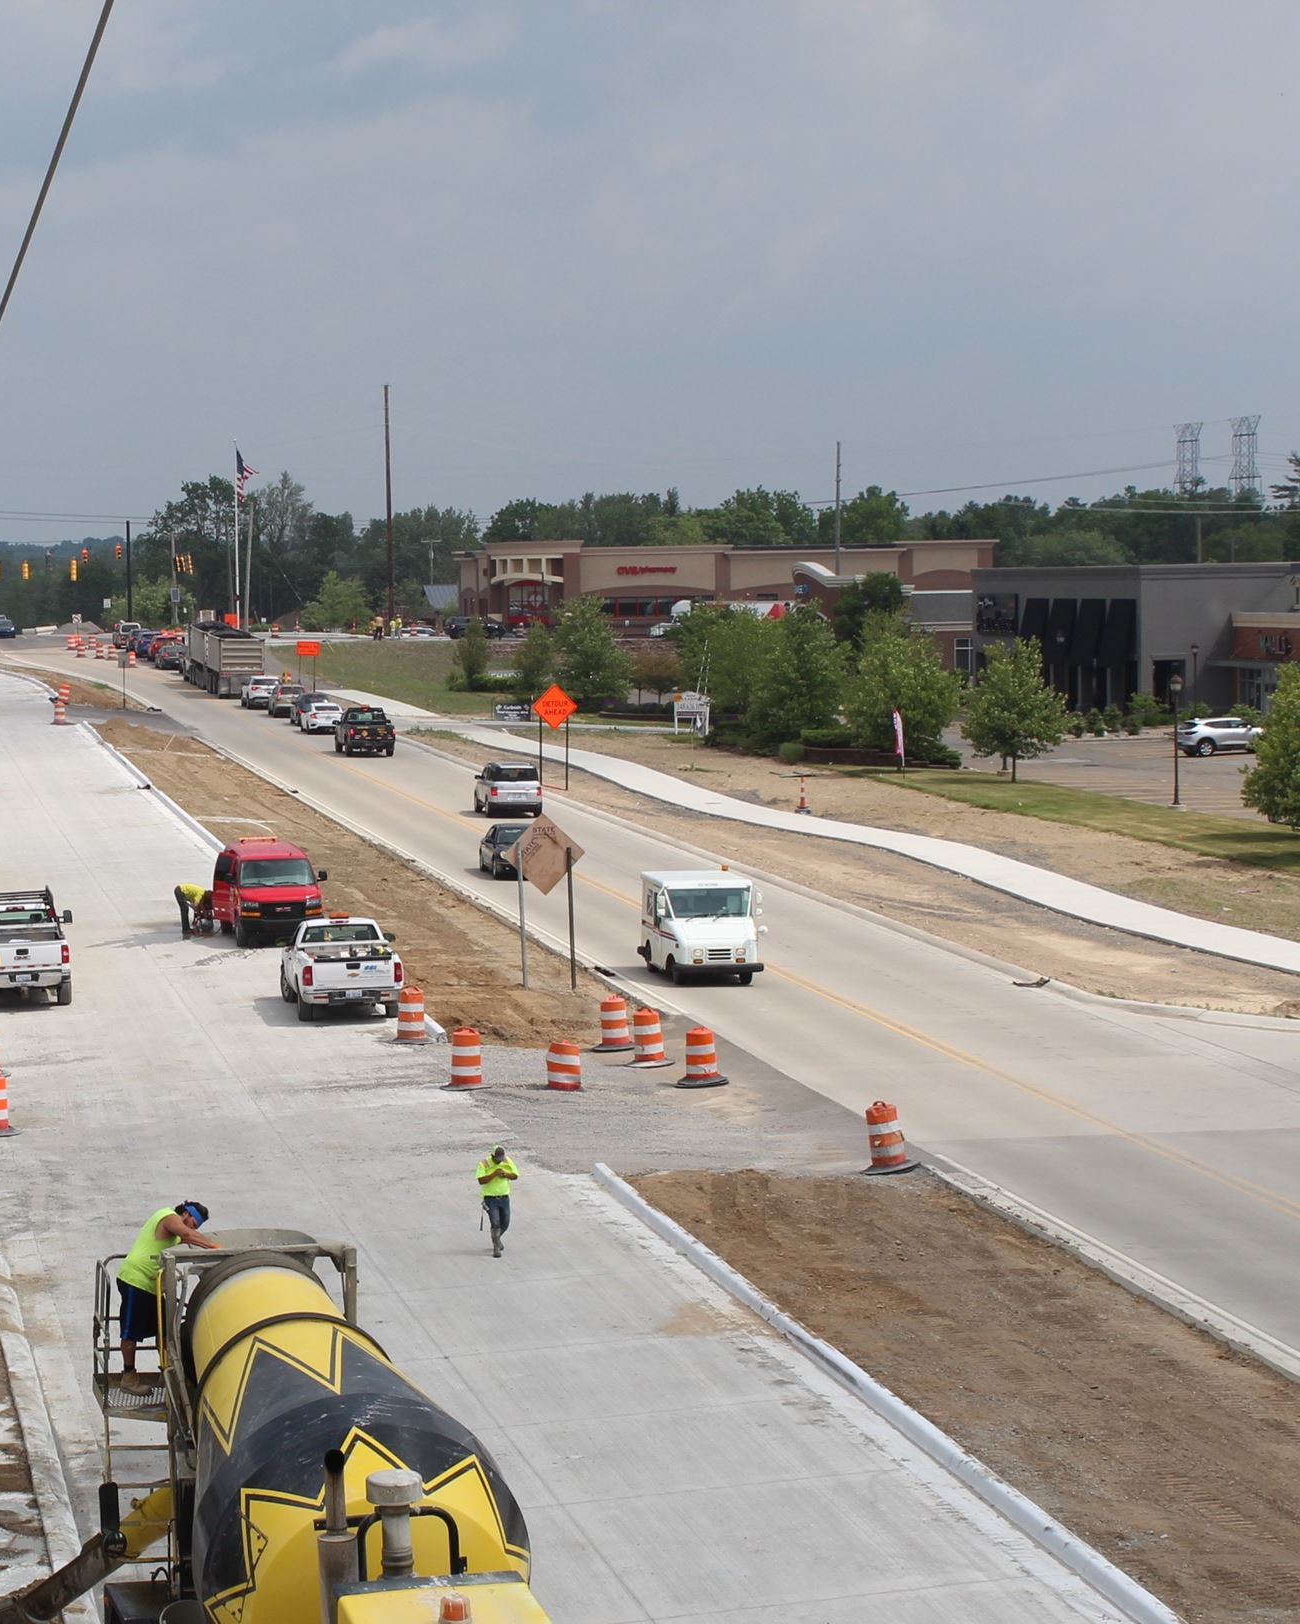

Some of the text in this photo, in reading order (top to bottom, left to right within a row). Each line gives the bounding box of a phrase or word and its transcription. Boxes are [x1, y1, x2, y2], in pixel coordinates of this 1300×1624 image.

[542, 700, 569, 708] DETOUR
[544, 708, 567, 716] AHEAD
[532, 826, 556, 834] STATE
